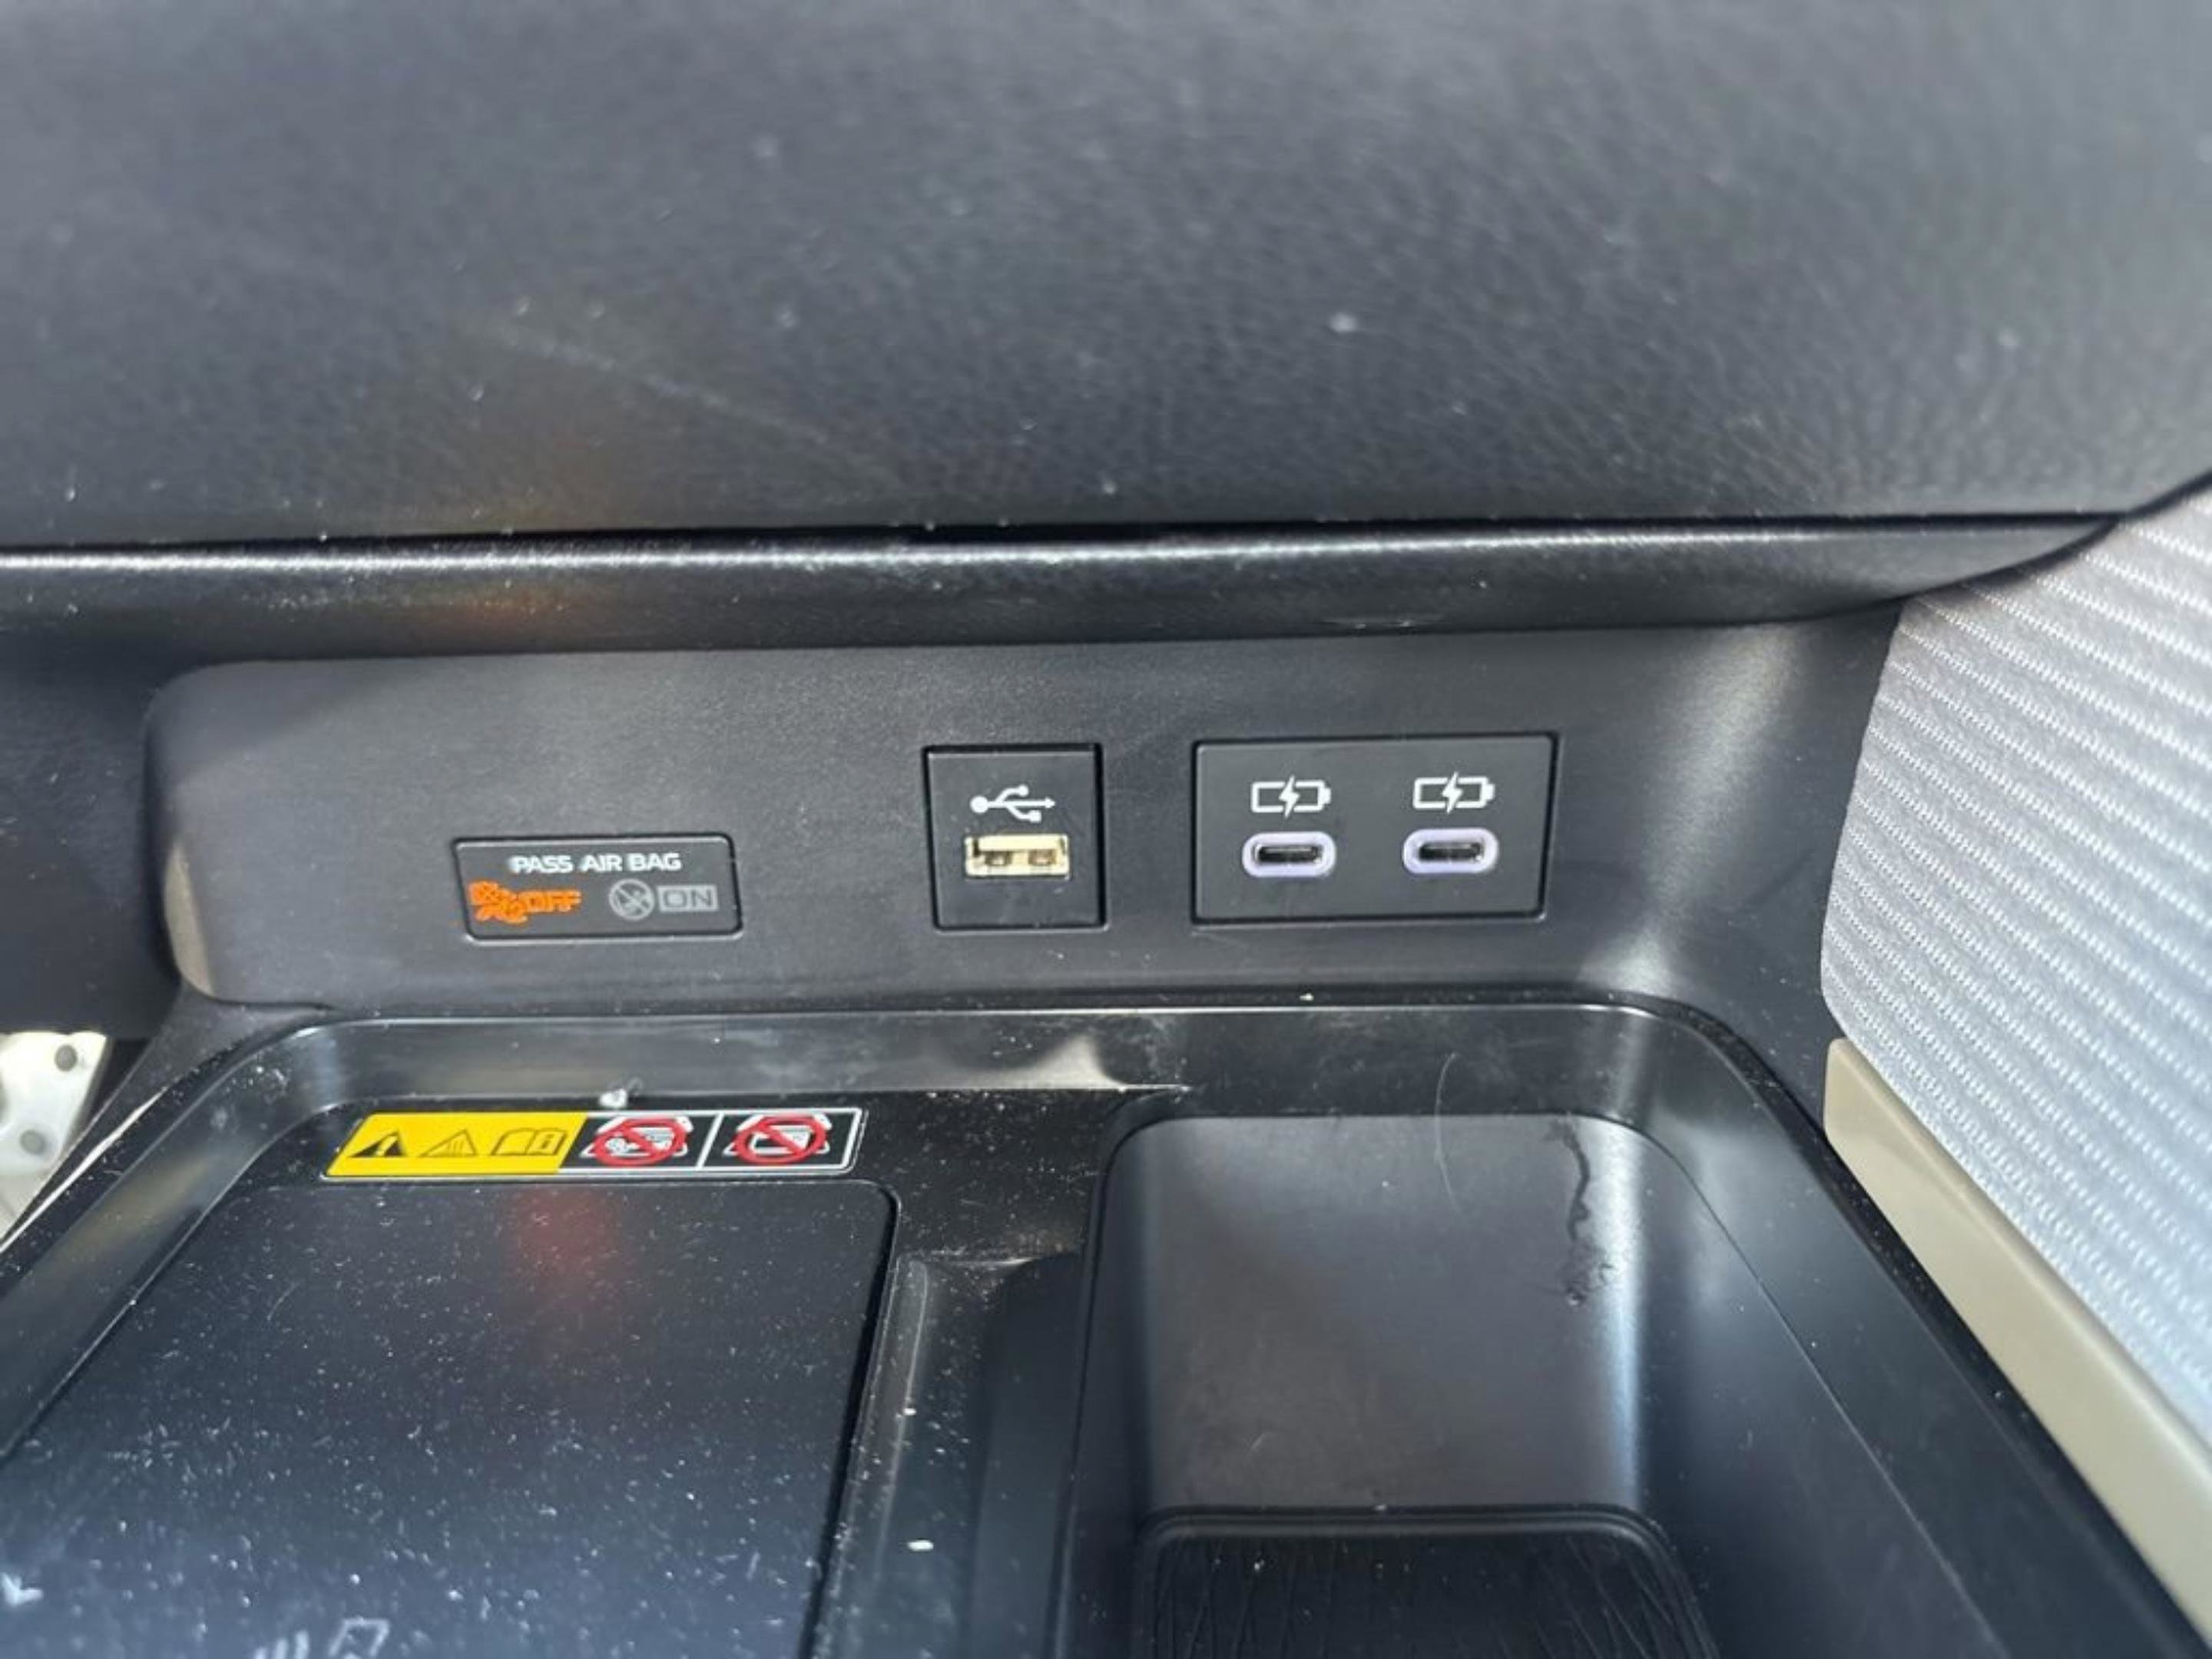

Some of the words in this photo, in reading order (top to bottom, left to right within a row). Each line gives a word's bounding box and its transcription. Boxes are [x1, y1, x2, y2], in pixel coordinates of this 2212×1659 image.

[509, 854, 573, 874] PASS
[579, 853, 623, 873] AIR
[627, 852, 682, 872] BAG
[522, 889, 581, 913] OFF
[661, 886, 716, 911] ON
